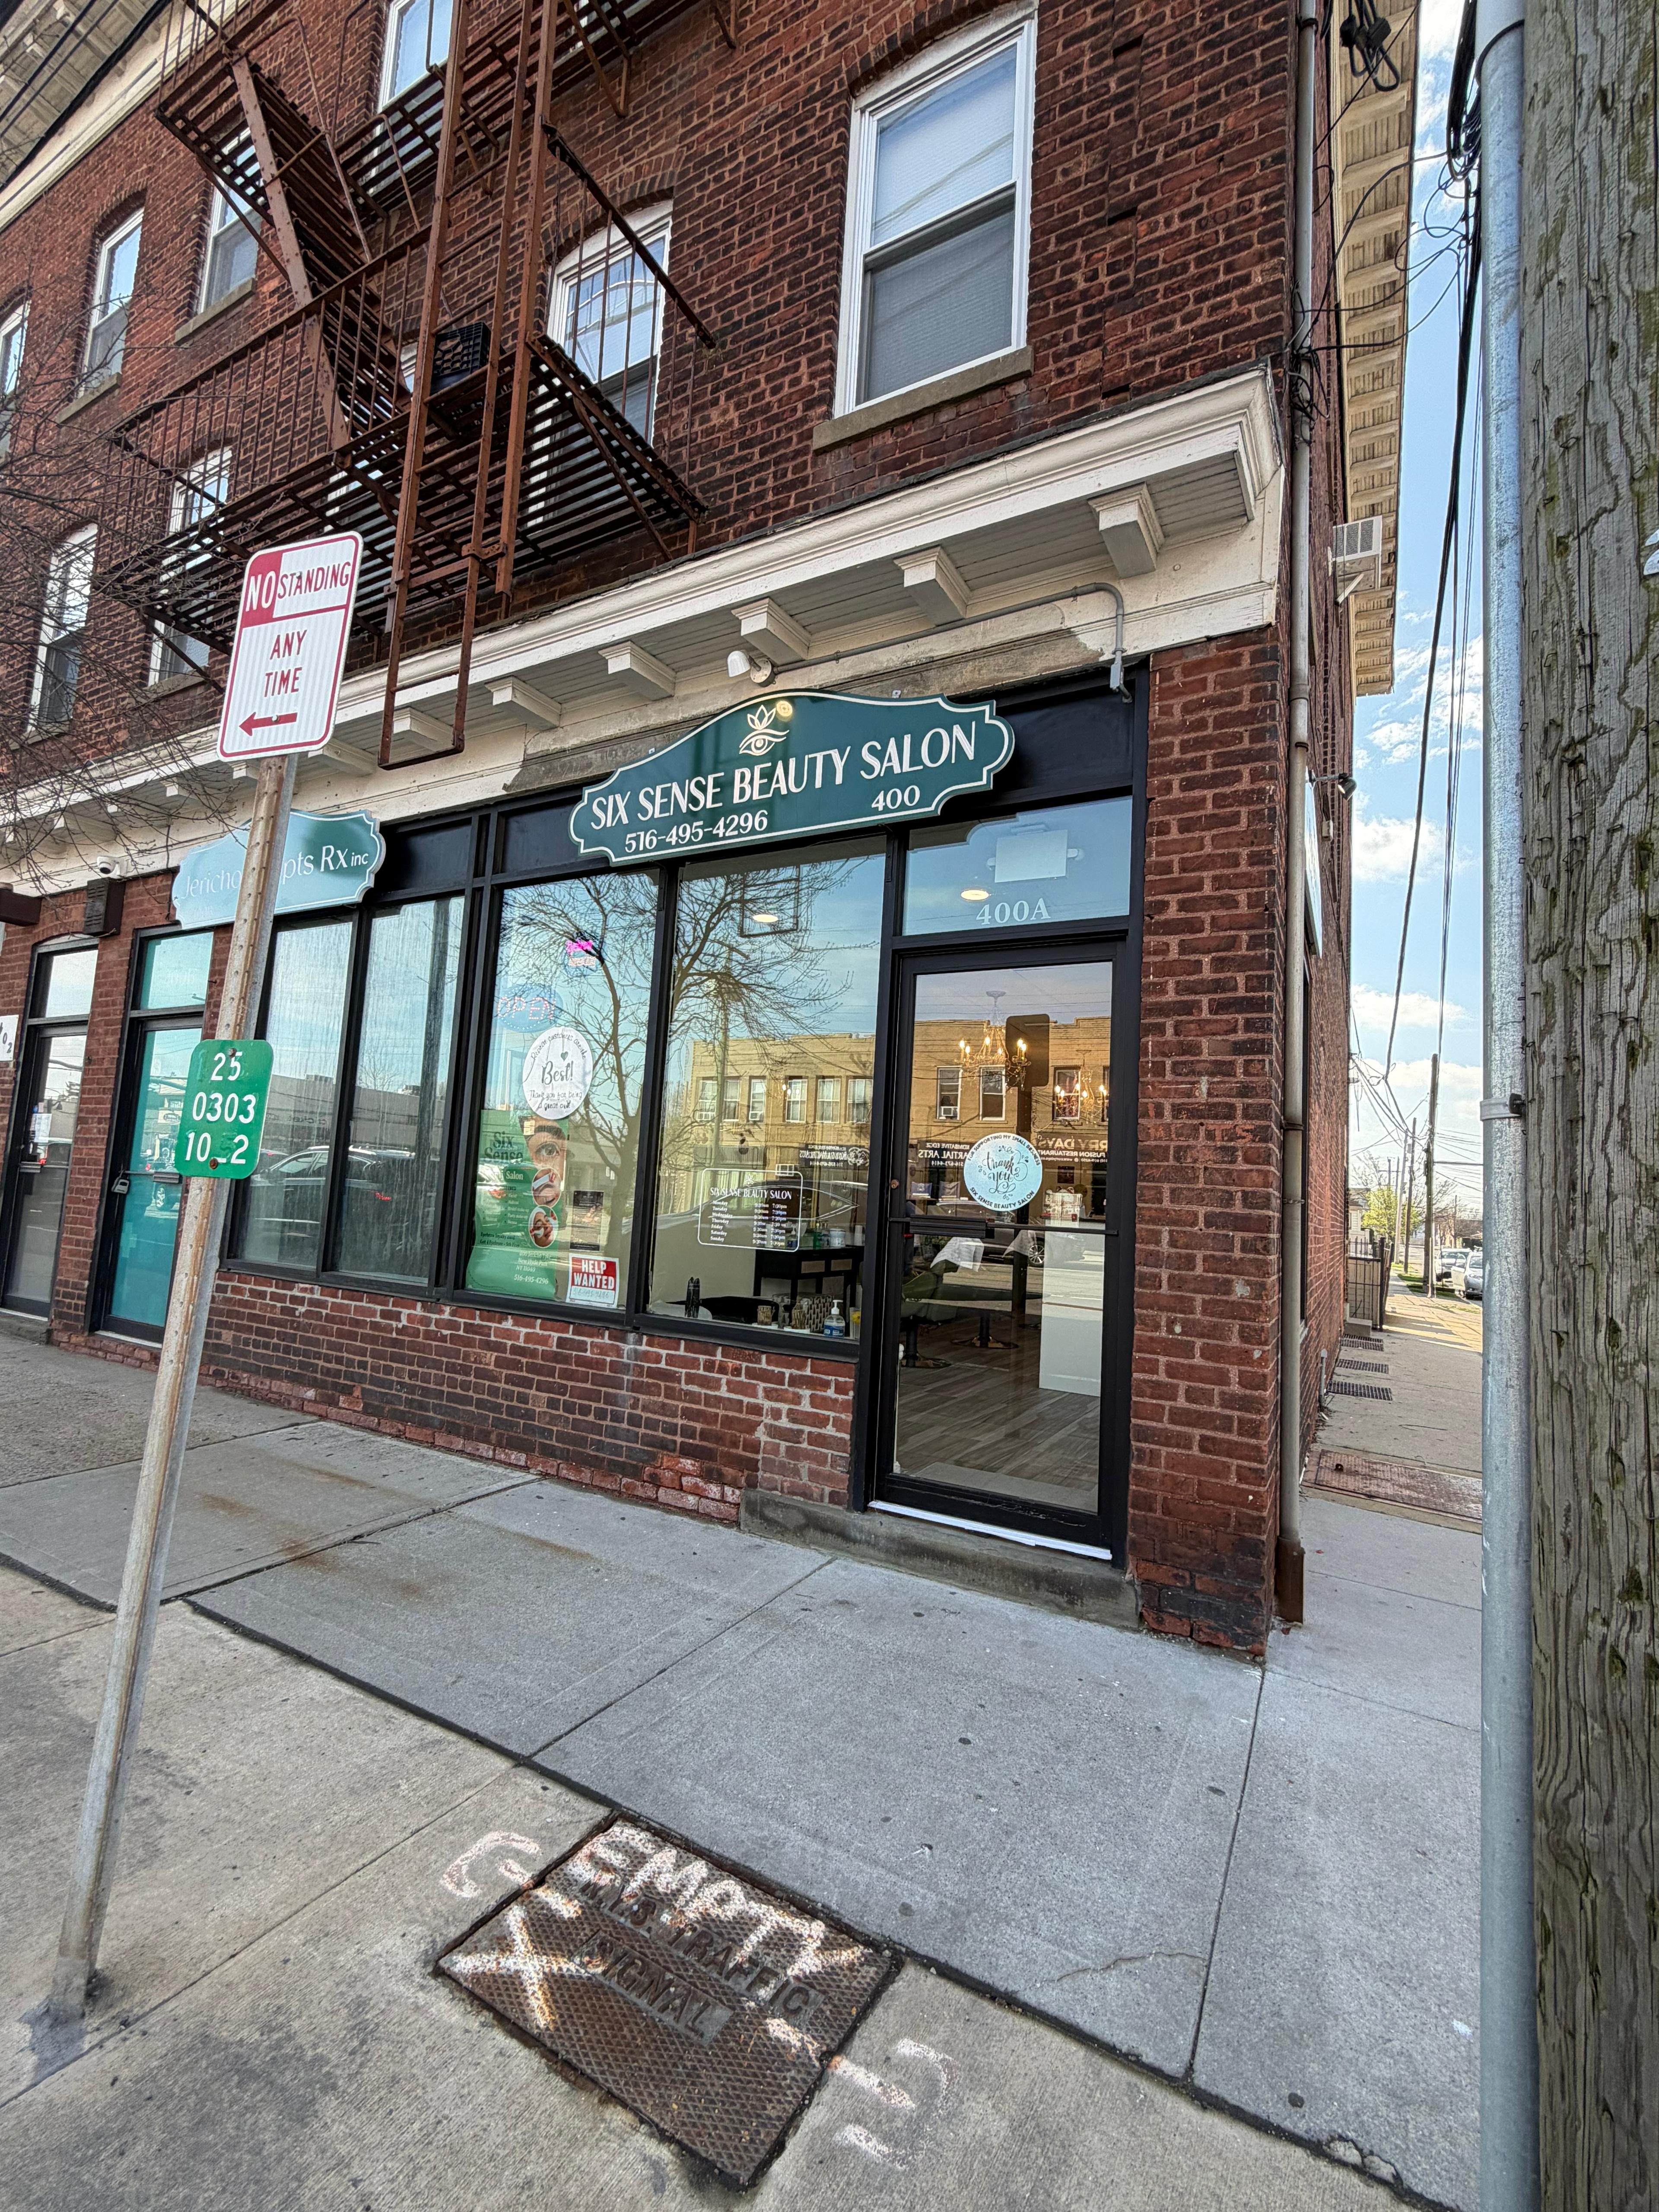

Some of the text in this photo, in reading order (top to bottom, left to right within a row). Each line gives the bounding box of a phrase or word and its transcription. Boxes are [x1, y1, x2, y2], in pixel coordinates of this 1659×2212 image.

[245, 561, 351, 612] NO STANDING
[270, 629, 307, 660] ANY
[264, 667, 302, 697] TIME
[591, 721, 975, 830] SIX SENSE BEAUTY SALON
[871, 785, 920, 811] 400
[625, 810, 768, 853] 516-495-4296
[181, 870, 242, 899] Jericho
[283, 851, 314, 884] pts
[351, 852, 369, 867] inc
[976, 897, 1051, 925] 400A
[498, 996, 556, 1020] OPEN
[211, 1051, 243, 1081] 25
[542, 1061, 574, 1085] Best!
[193, 1092, 256, 1124] 0303
[493, 1131, 515, 1148] Six
[974, 1135, 1002, 1152] SUPPORTING
[1012, 1136, 1026, 1146] SMALL
[484, 1147, 523, 1162] Sense
[506, 1171, 523, 1180] Salon
[710, 1187, 720, 1196] SIX
[744, 1189, 768, 1198] BEAUTY
[770, 1190, 792, 1200] SALON
[969, 1187, 979, 1196] SIX
[977, 1195, 993, 1207] SENSE
[1017, 1190, 1034, 1205] SALON
[514, 1274, 549, 1284] 516-495-4296
[582, 1260, 606, 1274] HELP
[574, 1272, 614, 1289] WANTED
[562, 1821, 871, 1979] EMPTY
[581, 1938, 712, 2036] SIGNAL
